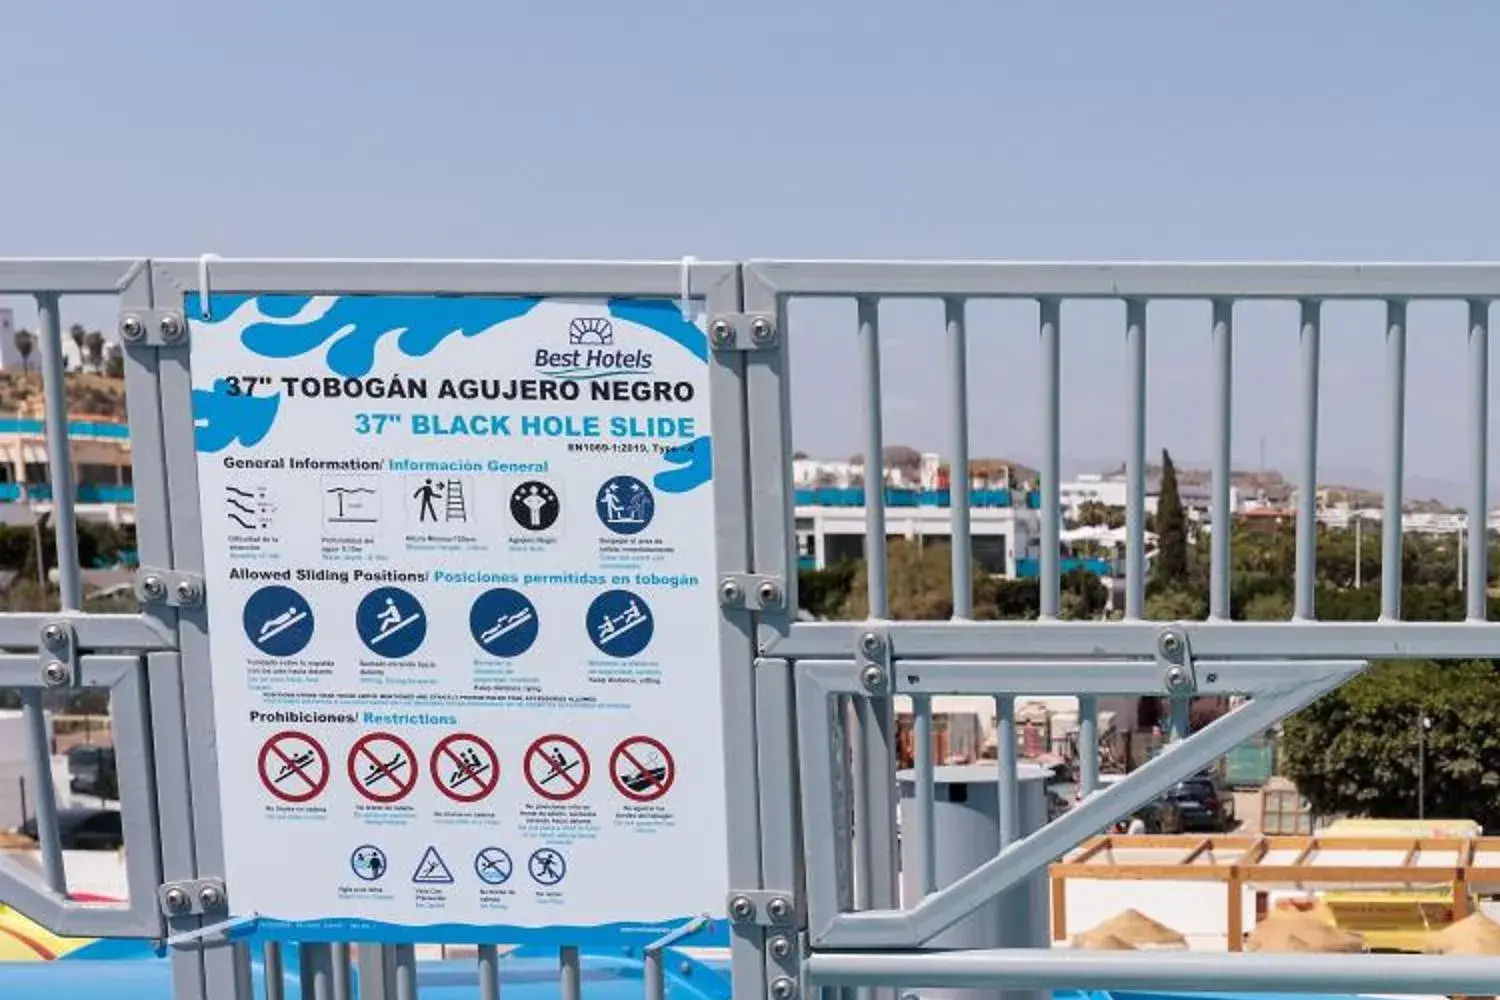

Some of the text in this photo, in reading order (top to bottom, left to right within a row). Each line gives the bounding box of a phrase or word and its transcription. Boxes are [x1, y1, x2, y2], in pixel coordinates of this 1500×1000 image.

[534, 349, 652, 369] Best Hotels
[225, 373, 695, 402] 37" TOBOGÁN AGUJERO NEGRO
[354, 413, 695, 437] 37" BLACK HOLE SLIDE
[223, 457, 285, 469] General
[388, 459, 482, 471] Información
[487, 460, 548, 472] General
[229, 569, 291, 581] Allowed
[296, 569, 349, 584] Sliding
[434, 572, 518, 584] Posiciones
[523, 572, 606, 588] permitidas
[612, 577, 631, 585] en
[635, 573, 699, 588] tobogán
[363, 712, 457, 726] Restrictions
